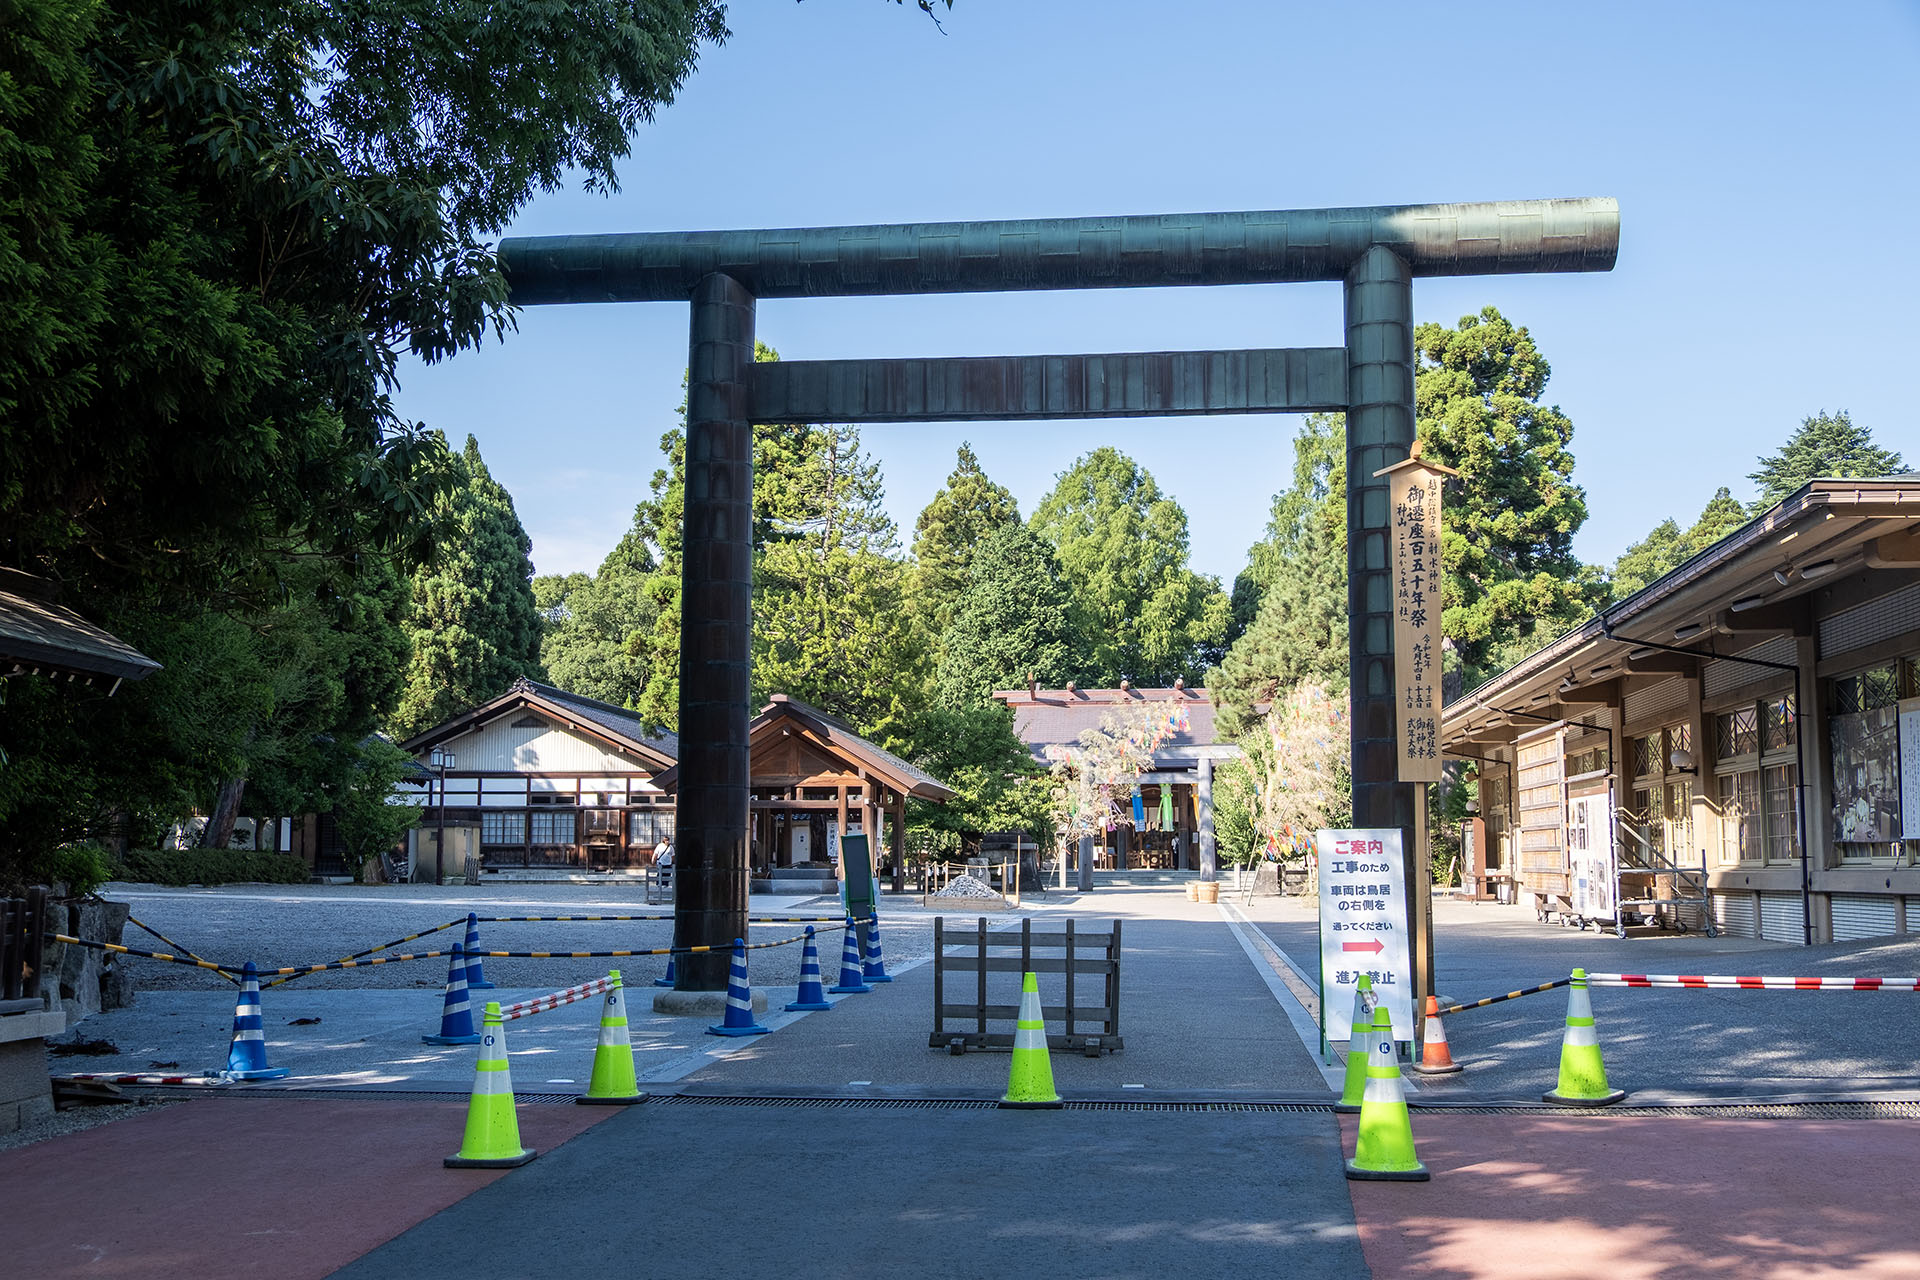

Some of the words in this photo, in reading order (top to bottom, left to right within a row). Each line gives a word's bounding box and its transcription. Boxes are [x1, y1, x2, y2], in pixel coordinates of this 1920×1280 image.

[1407, 485, 1428, 629] 御遷座百五十年祭
[1428, 542, 1438, 593] 射水神社
[1422, 634, 1432, 669] 令和七年
[1335, 839, 1384, 855] ご案内
[1331, 860, 1390, 874] 工事のため
[1330, 884, 1391, 896] 車両は鳥居
[1338, 900, 1386, 911] の右側を
[1332, 922, 1393, 931] 通ってください
